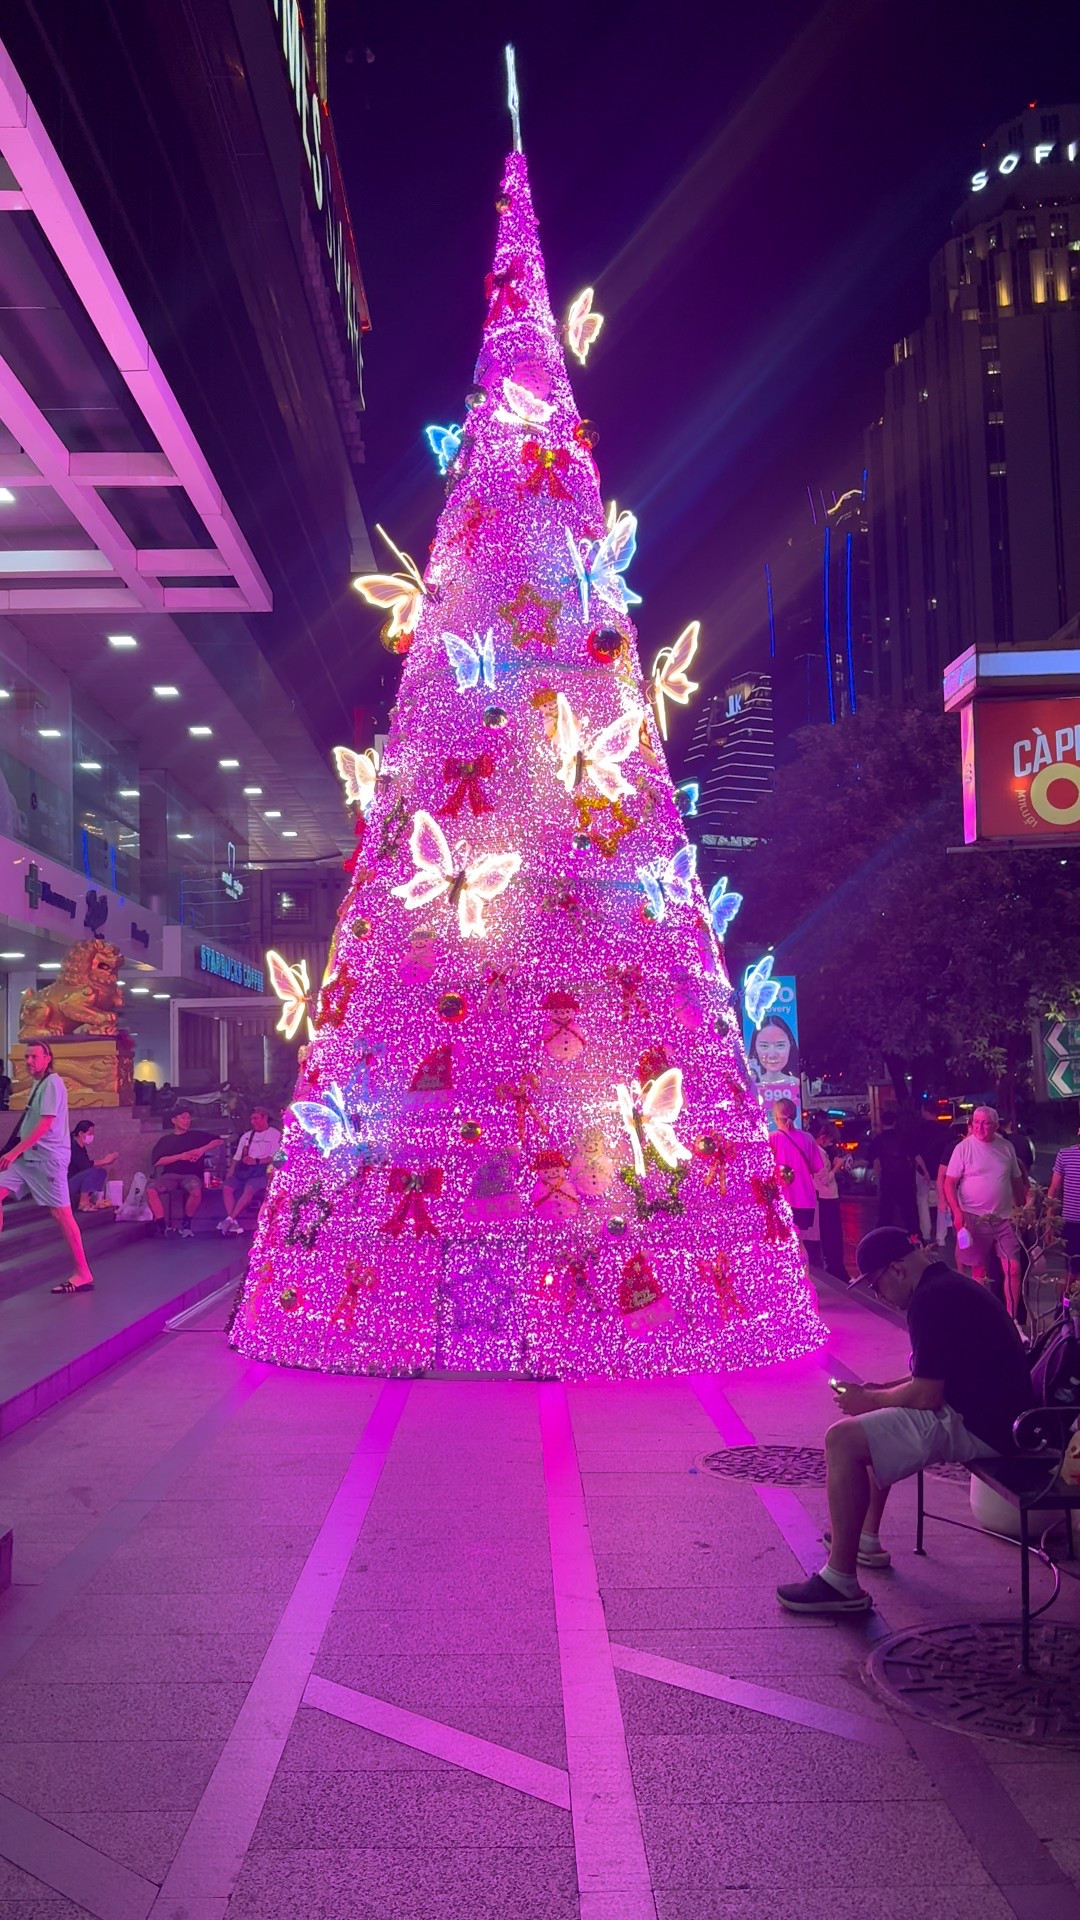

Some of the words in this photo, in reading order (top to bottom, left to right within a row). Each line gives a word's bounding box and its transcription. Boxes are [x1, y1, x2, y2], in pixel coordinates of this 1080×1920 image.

[970, 142, 1078, 192] SOFI
[200, 944, 243, 985] STARBUCKS
[242, 963, 264, 993] COFFEE
